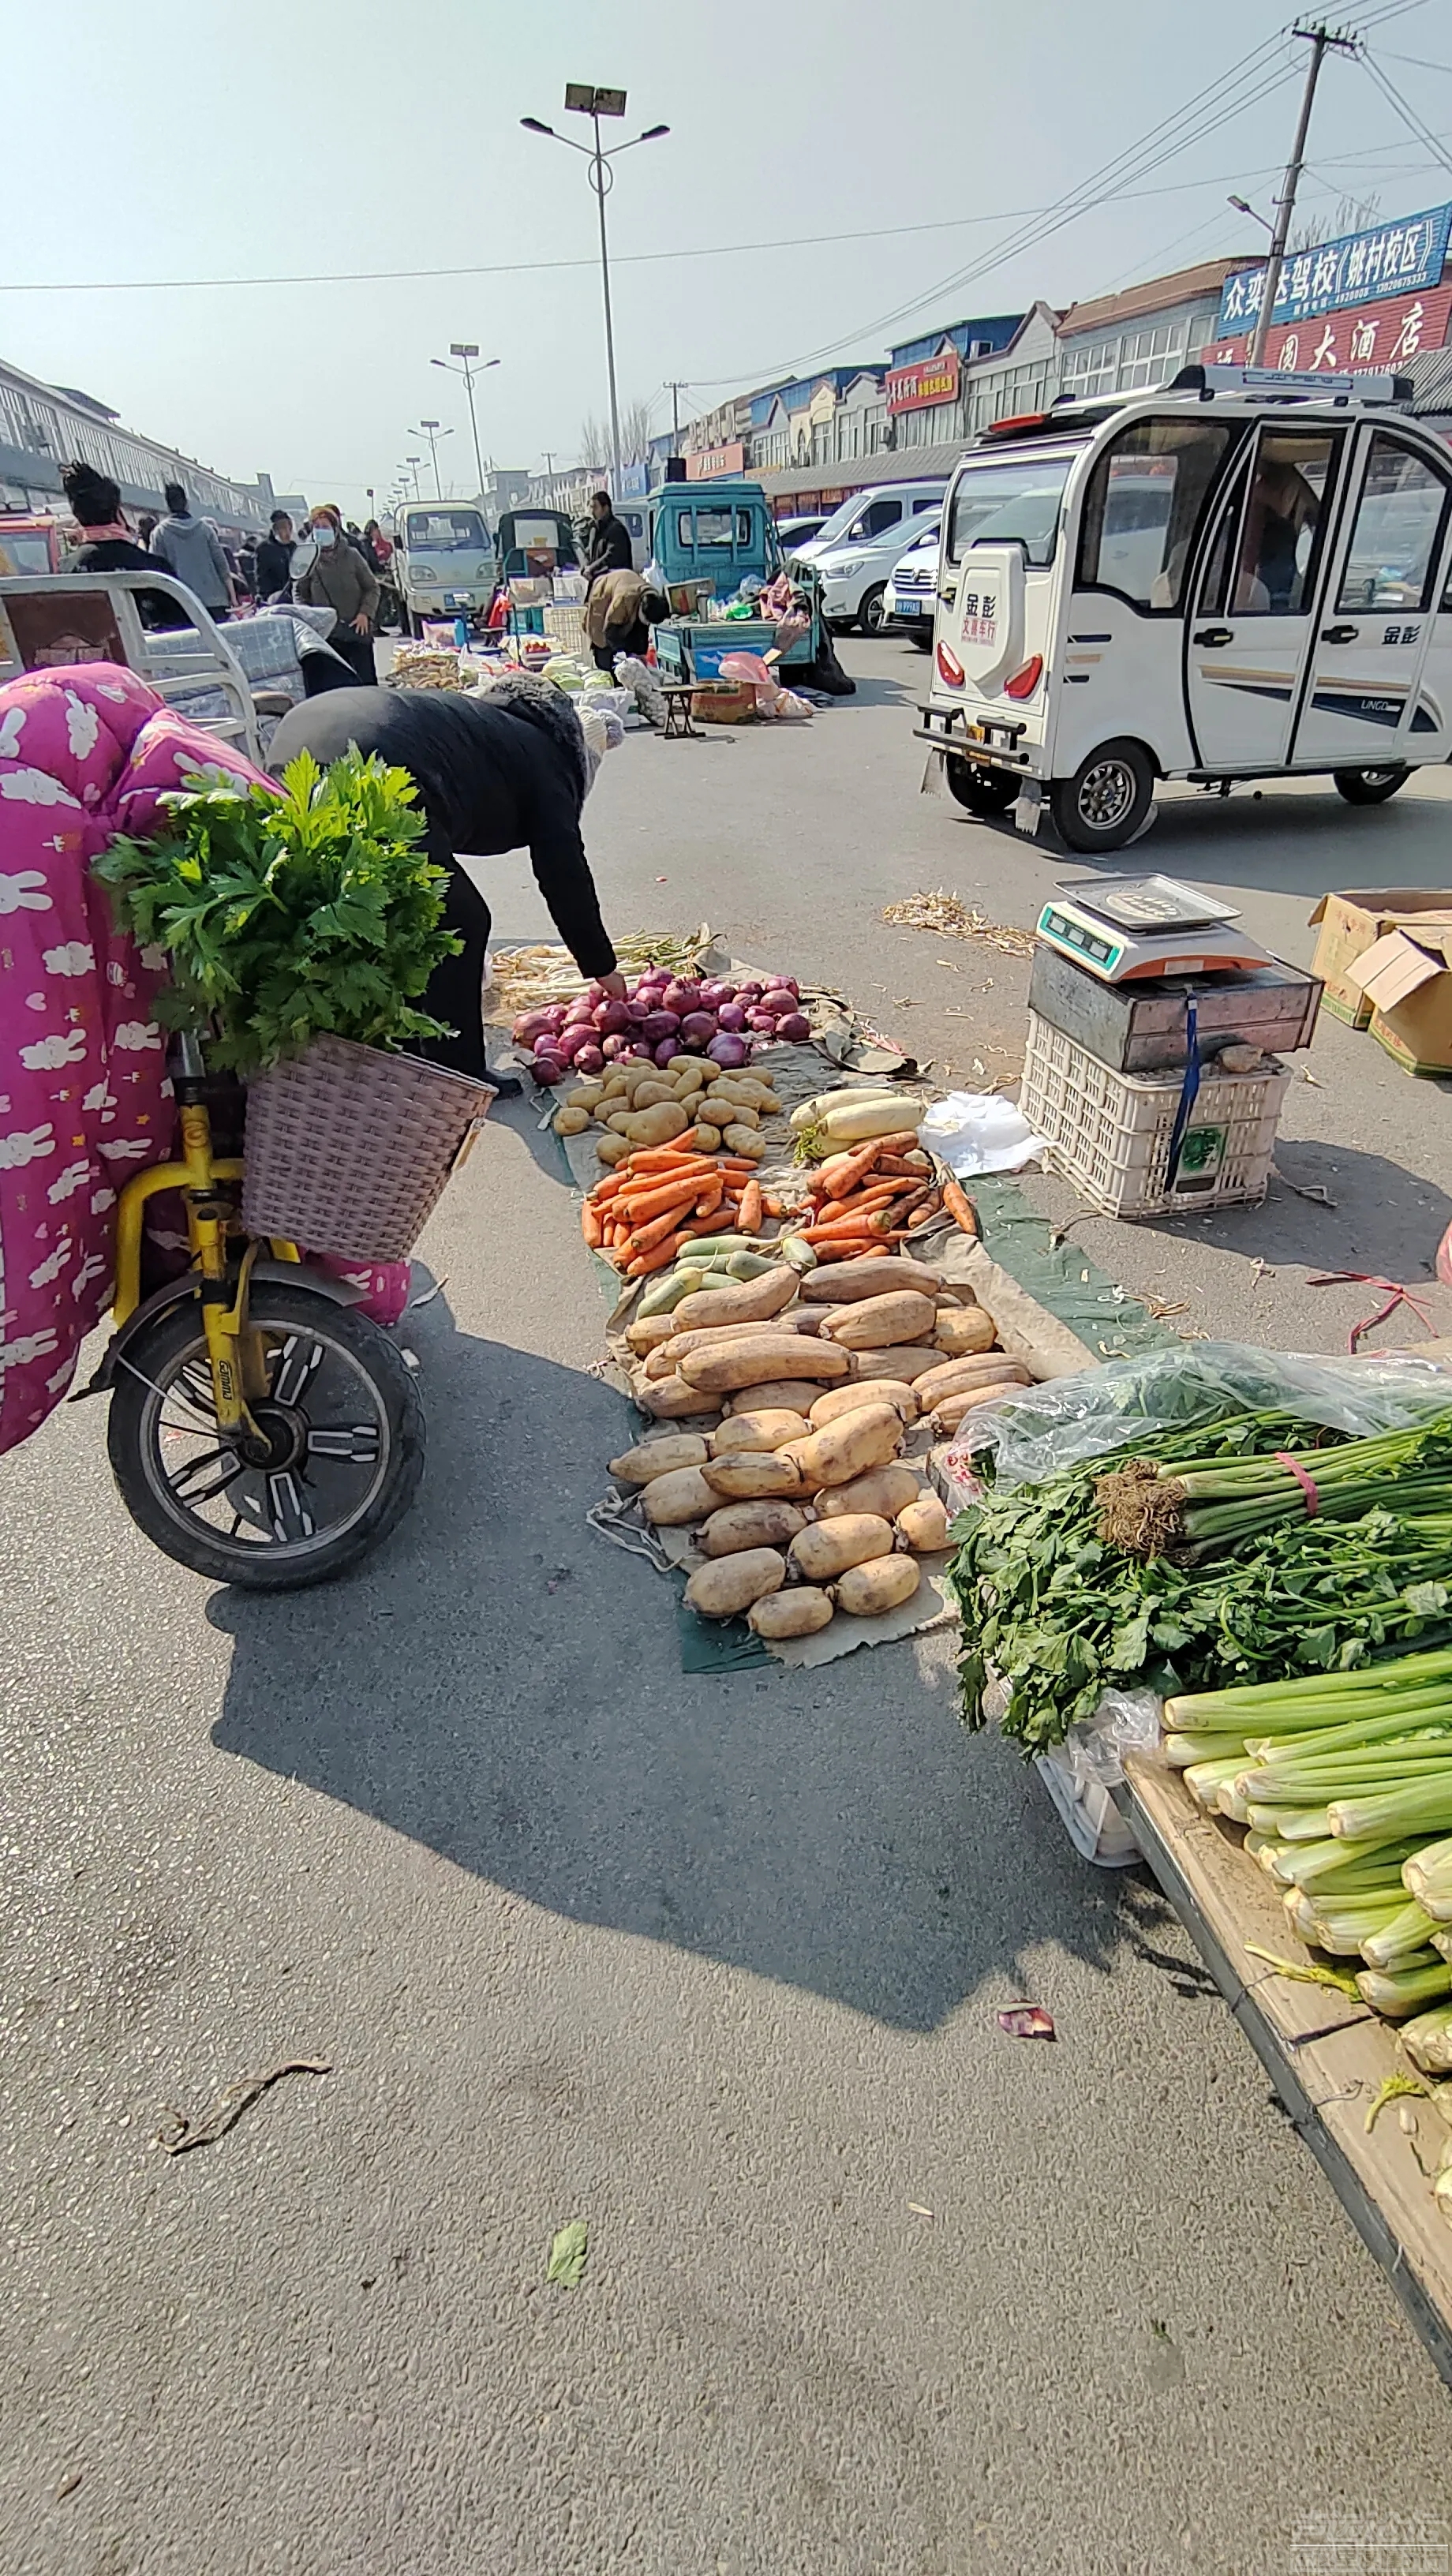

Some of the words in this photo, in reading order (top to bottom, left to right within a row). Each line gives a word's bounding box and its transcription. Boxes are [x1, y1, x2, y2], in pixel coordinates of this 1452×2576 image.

[1217, 301, 1424, 372] 圆大酒店
[966, 593, 996, 618] 金彭
[1381, 624, 1421, 645] 金彭
